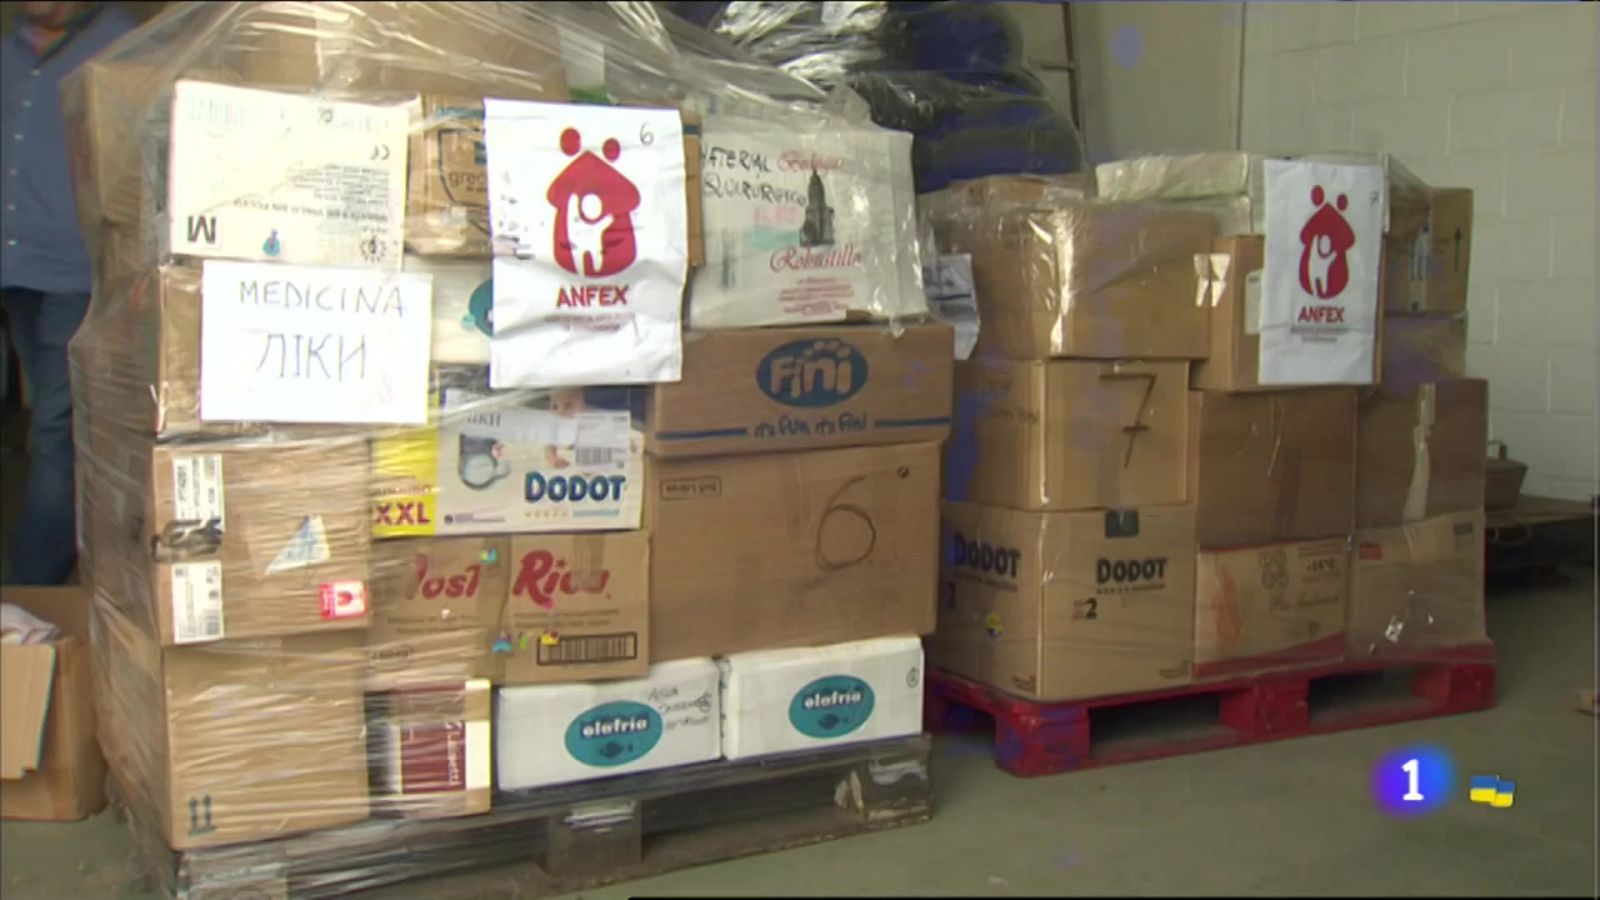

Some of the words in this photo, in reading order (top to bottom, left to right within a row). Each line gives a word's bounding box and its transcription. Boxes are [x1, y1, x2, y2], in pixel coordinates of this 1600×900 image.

[639, 122, 655, 147] 6
[187, 214, 217, 245] M
[239, 279, 406, 318] MEDICINA
[556, 284, 630, 308] ANFEX
[1297, 305, 1345, 324] ANFEX
[255, 332, 367, 383] ЛІКИ
[1099, 372, 1158, 469] 7
[524, 470, 627, 504] DODOT
[374, 501, 433, 525] XXL
[816, 475, 877, 571] 6
[953, 532, 1022, 580] DODOT
[1096, 556, 1168, 585] DODOT
